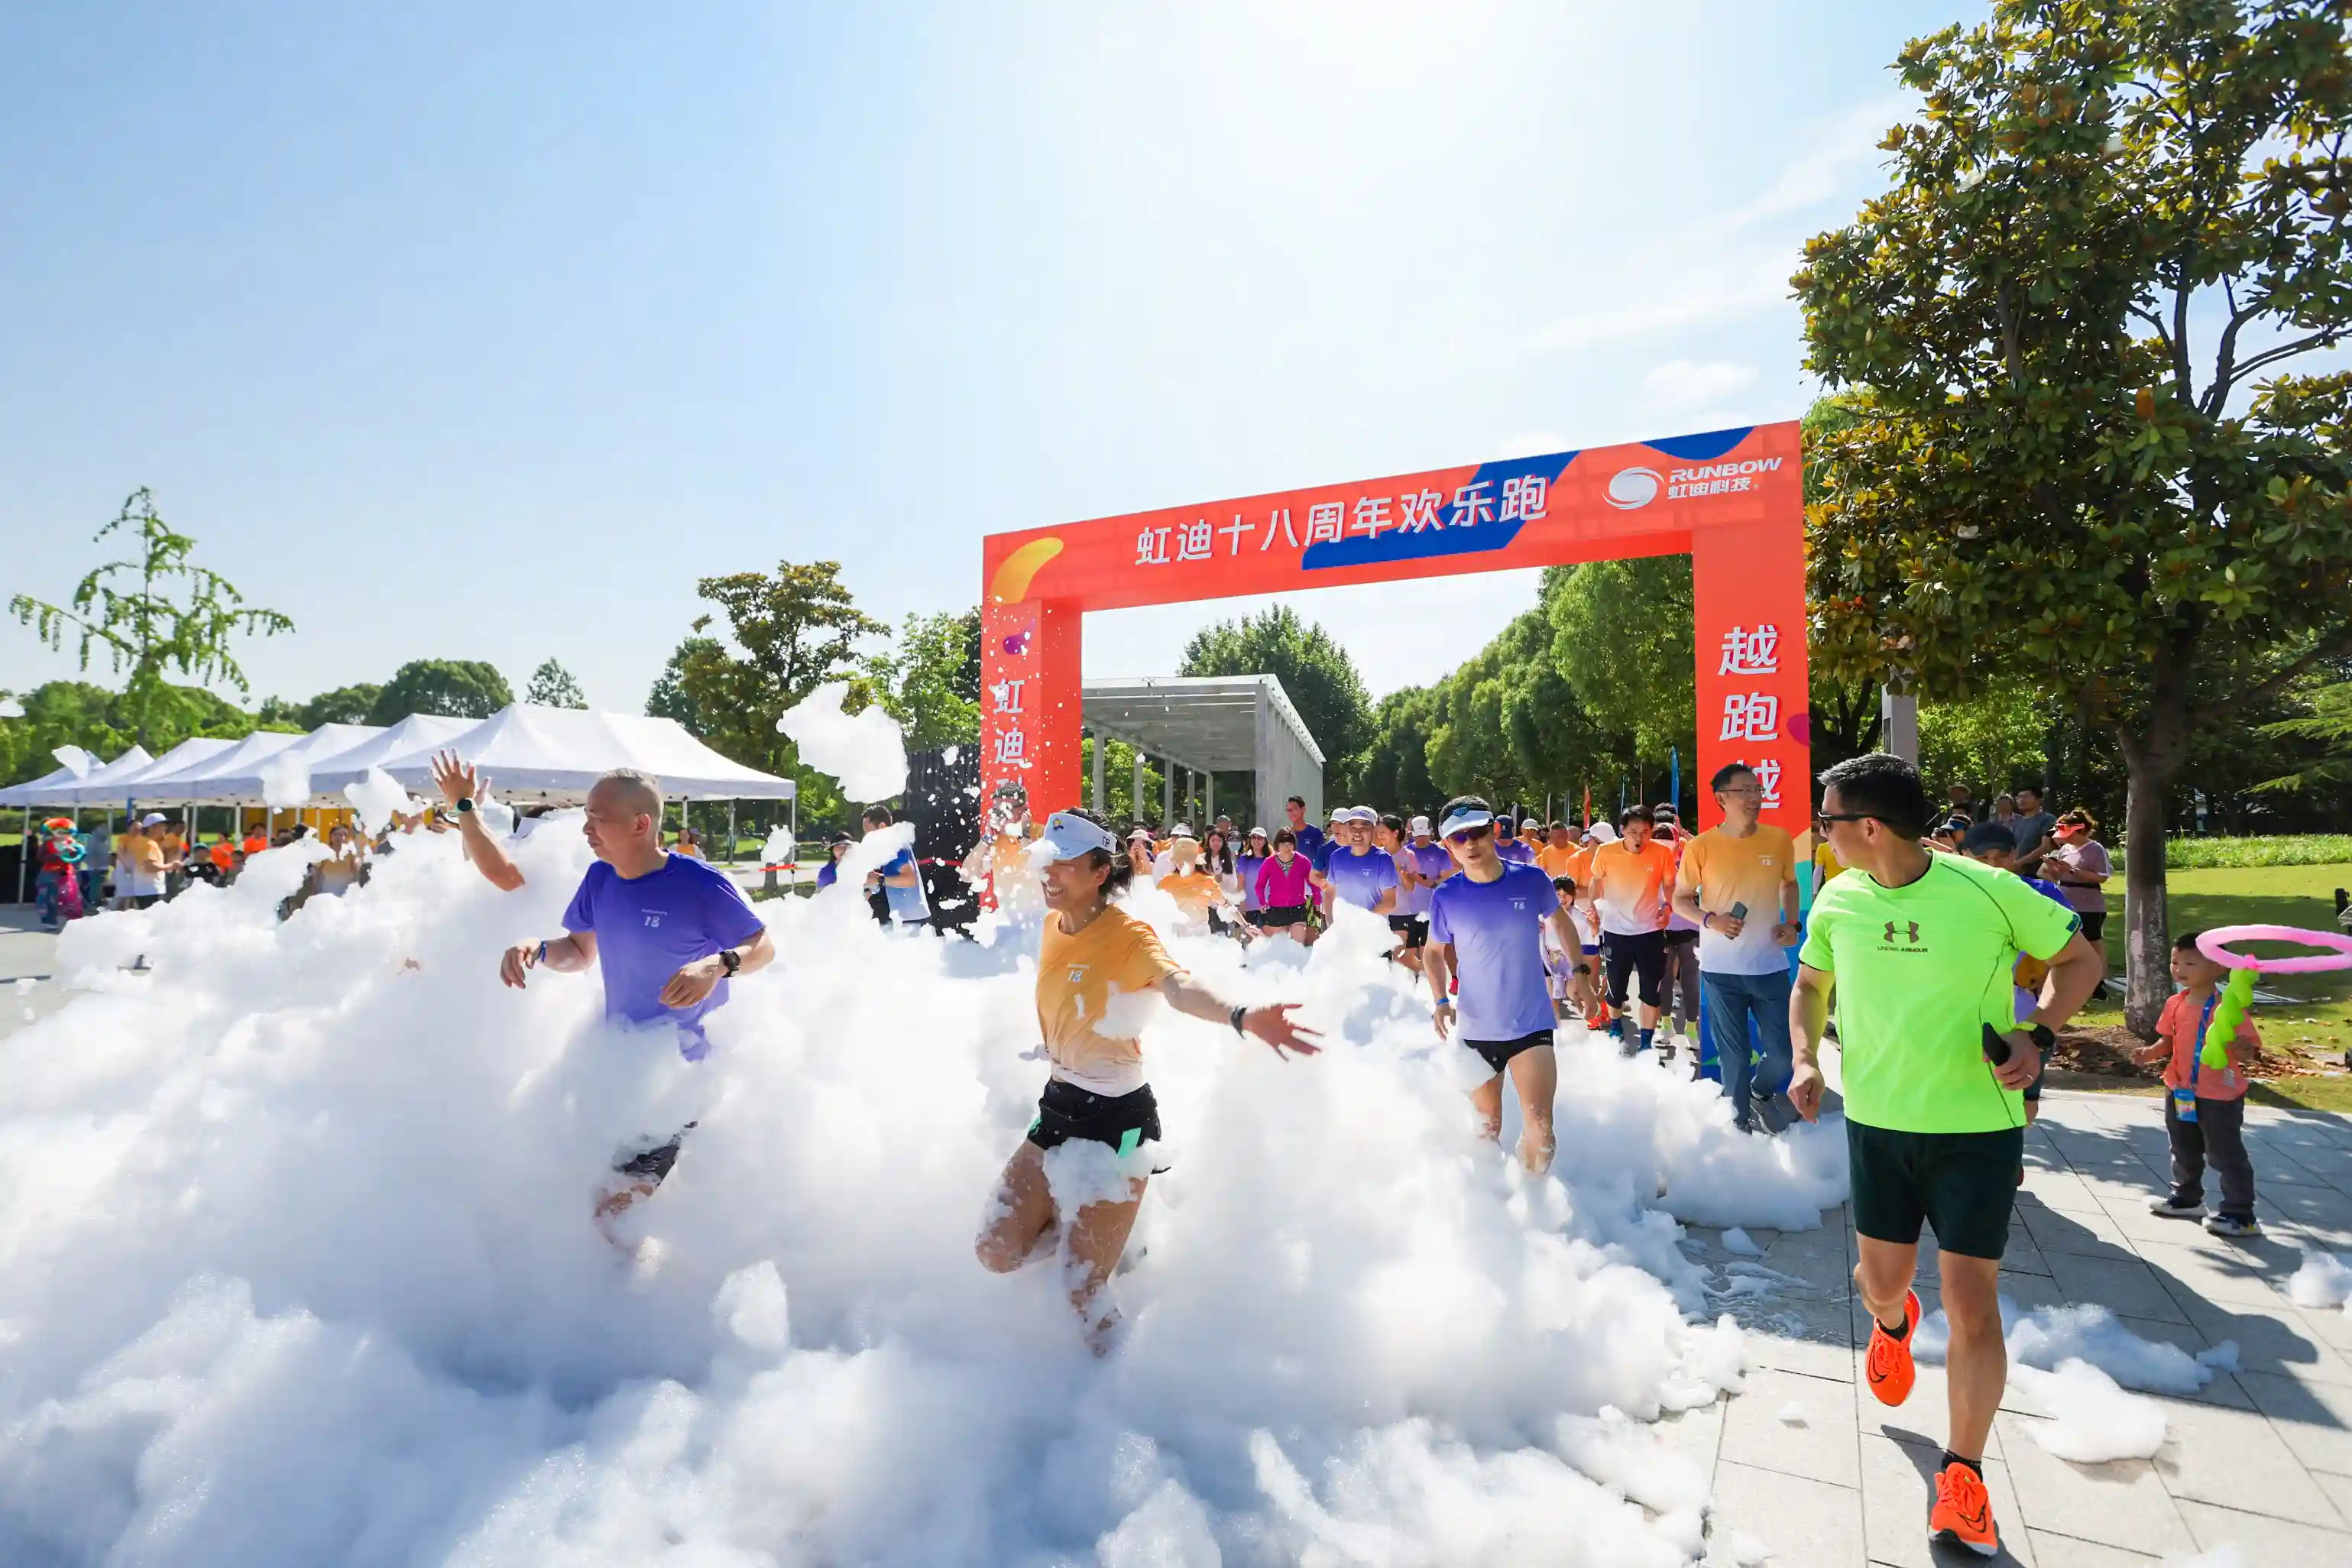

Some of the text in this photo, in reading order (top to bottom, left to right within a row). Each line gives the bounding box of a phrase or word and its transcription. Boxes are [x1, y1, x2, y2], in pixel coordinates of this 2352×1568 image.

[1669, 457, 1783, 484] RUNBOW
[1667, 477, 1752, 501] 虹迪科技
[1134, 474, 1548, 565] 虹迪十八周年欢乐跑
[992, 678, 1026, 789] 虹迪
[1514, 901, 1525, 910] 18
[644, 915, 660, 928] 18
[1067, 970, 1083, 983] 18
